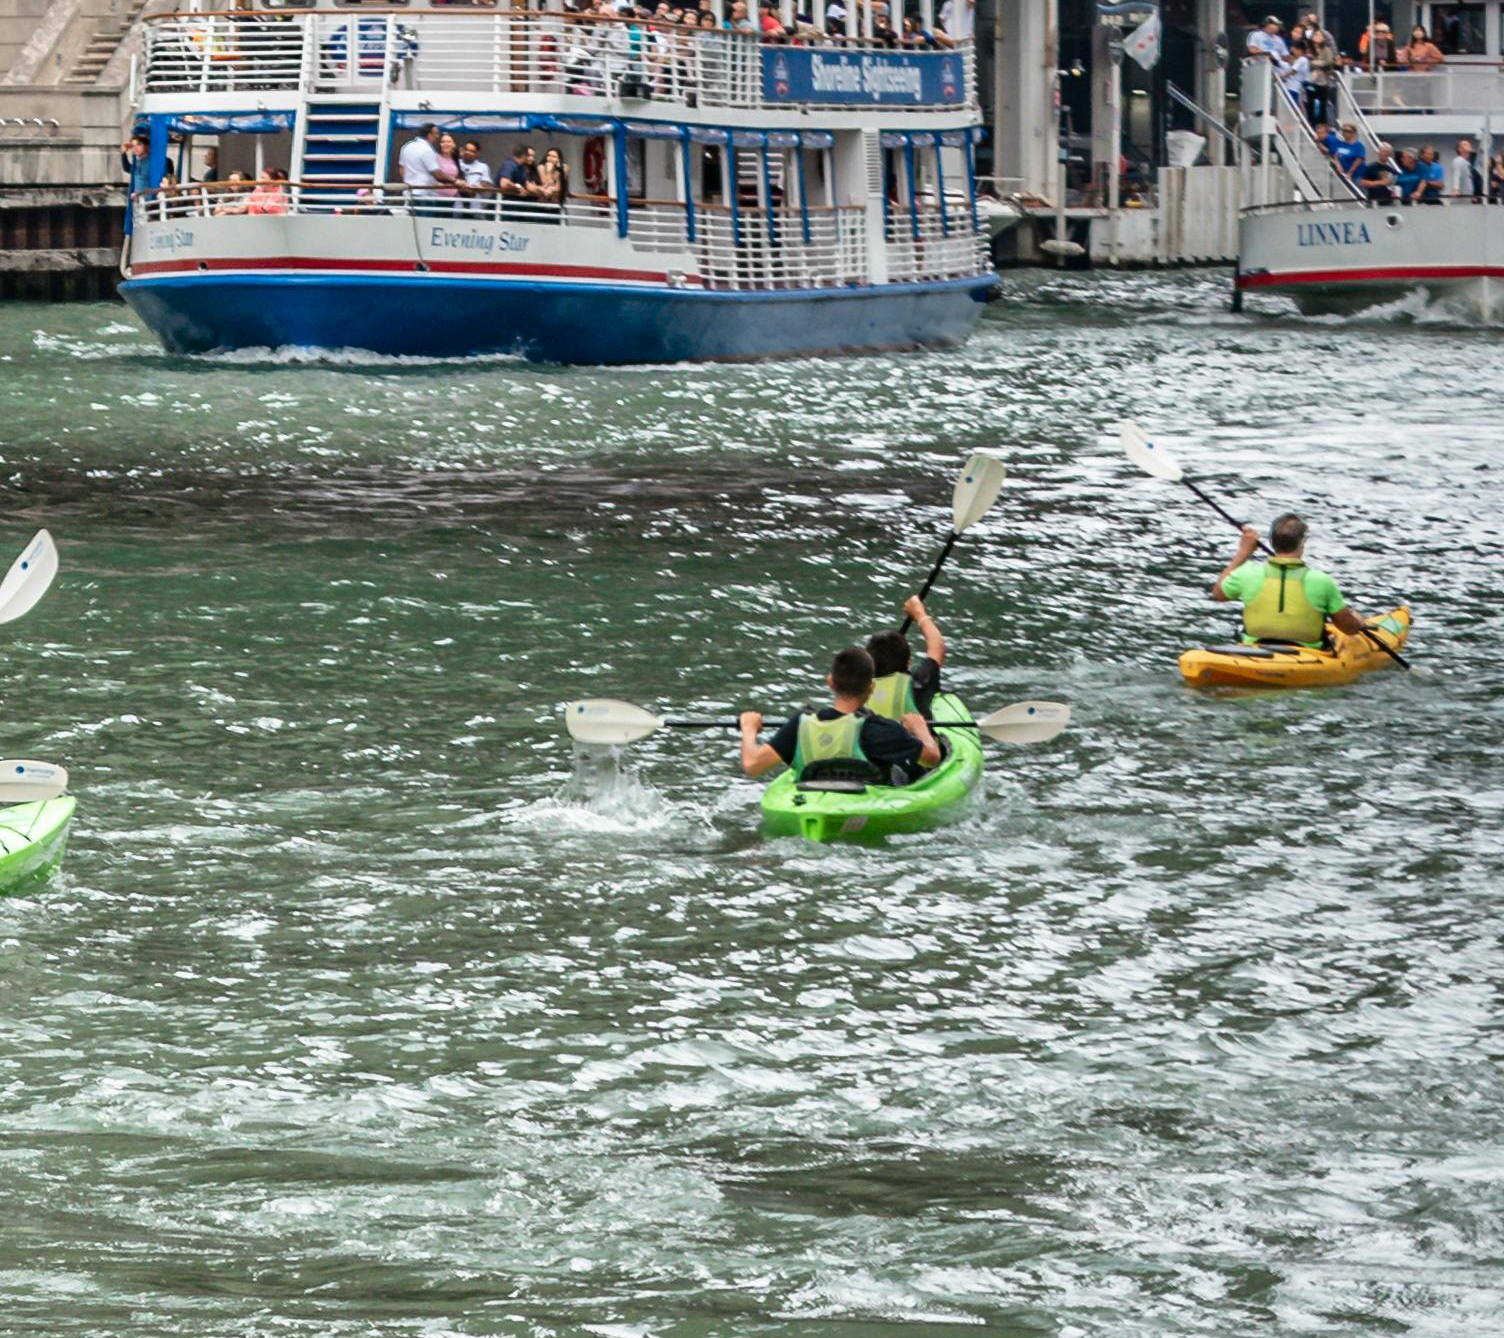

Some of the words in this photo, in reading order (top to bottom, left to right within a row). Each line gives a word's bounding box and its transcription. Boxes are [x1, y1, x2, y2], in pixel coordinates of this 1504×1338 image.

[431, 227, 494, 254] Evening
[498, 231, 530, 252] Star
[1296, 222, 1373, 247] LINNEA
